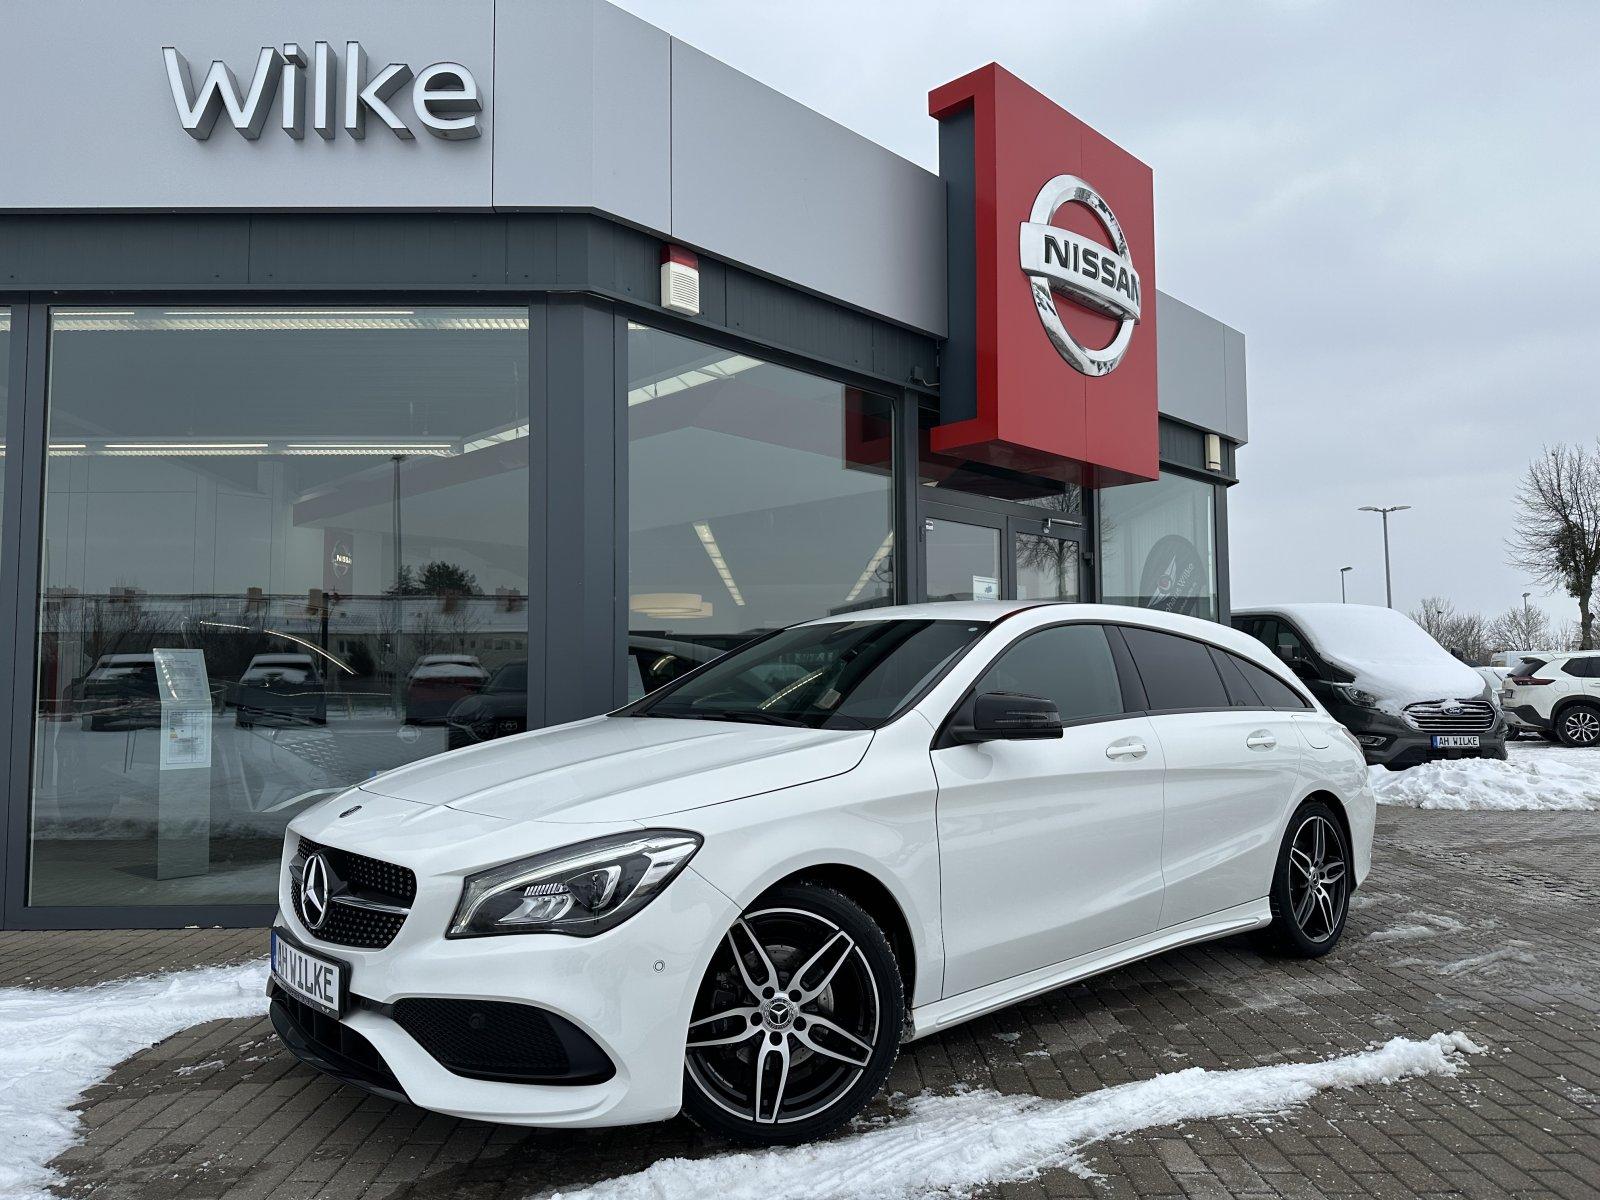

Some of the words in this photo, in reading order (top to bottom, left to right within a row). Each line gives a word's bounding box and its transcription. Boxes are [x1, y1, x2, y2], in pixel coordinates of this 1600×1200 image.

[161, 41, 482, 140] Wilke
[1044, 234, 1139, 306] NISSAN
[1439, 737, 1450, 746] AH
[1453, 737, 1478, 746] WILKE
[278, 942, 288, 979] AH
[290, 951, 334, 1004] WILKE
